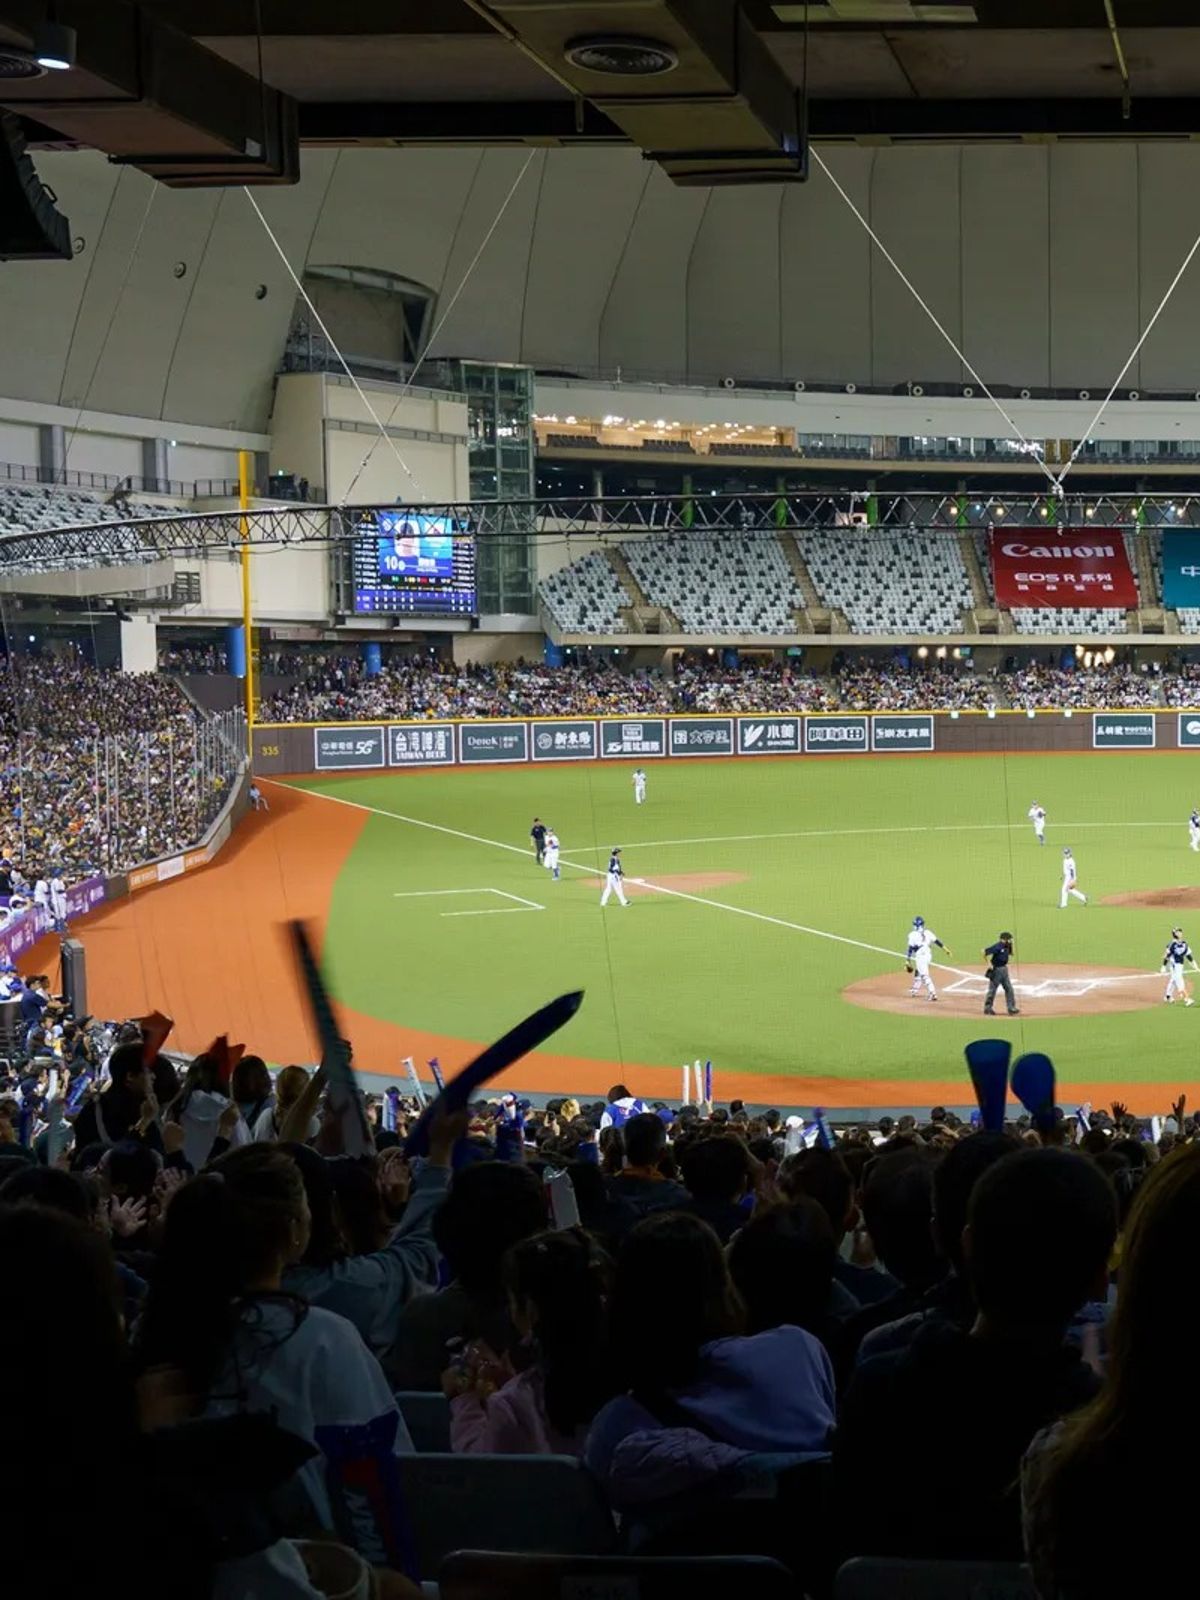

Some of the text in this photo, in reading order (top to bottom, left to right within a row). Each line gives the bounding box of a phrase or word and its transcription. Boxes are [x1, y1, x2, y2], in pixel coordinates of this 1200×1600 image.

[1001, 543, 1115, 558] Canon
[384, 556, 398, 570] 10
[1014, 572, 1060, 582] EOS
[1063, 573, 1076, 582] R
[395, 731, 446, 752] 台灣啤酒
